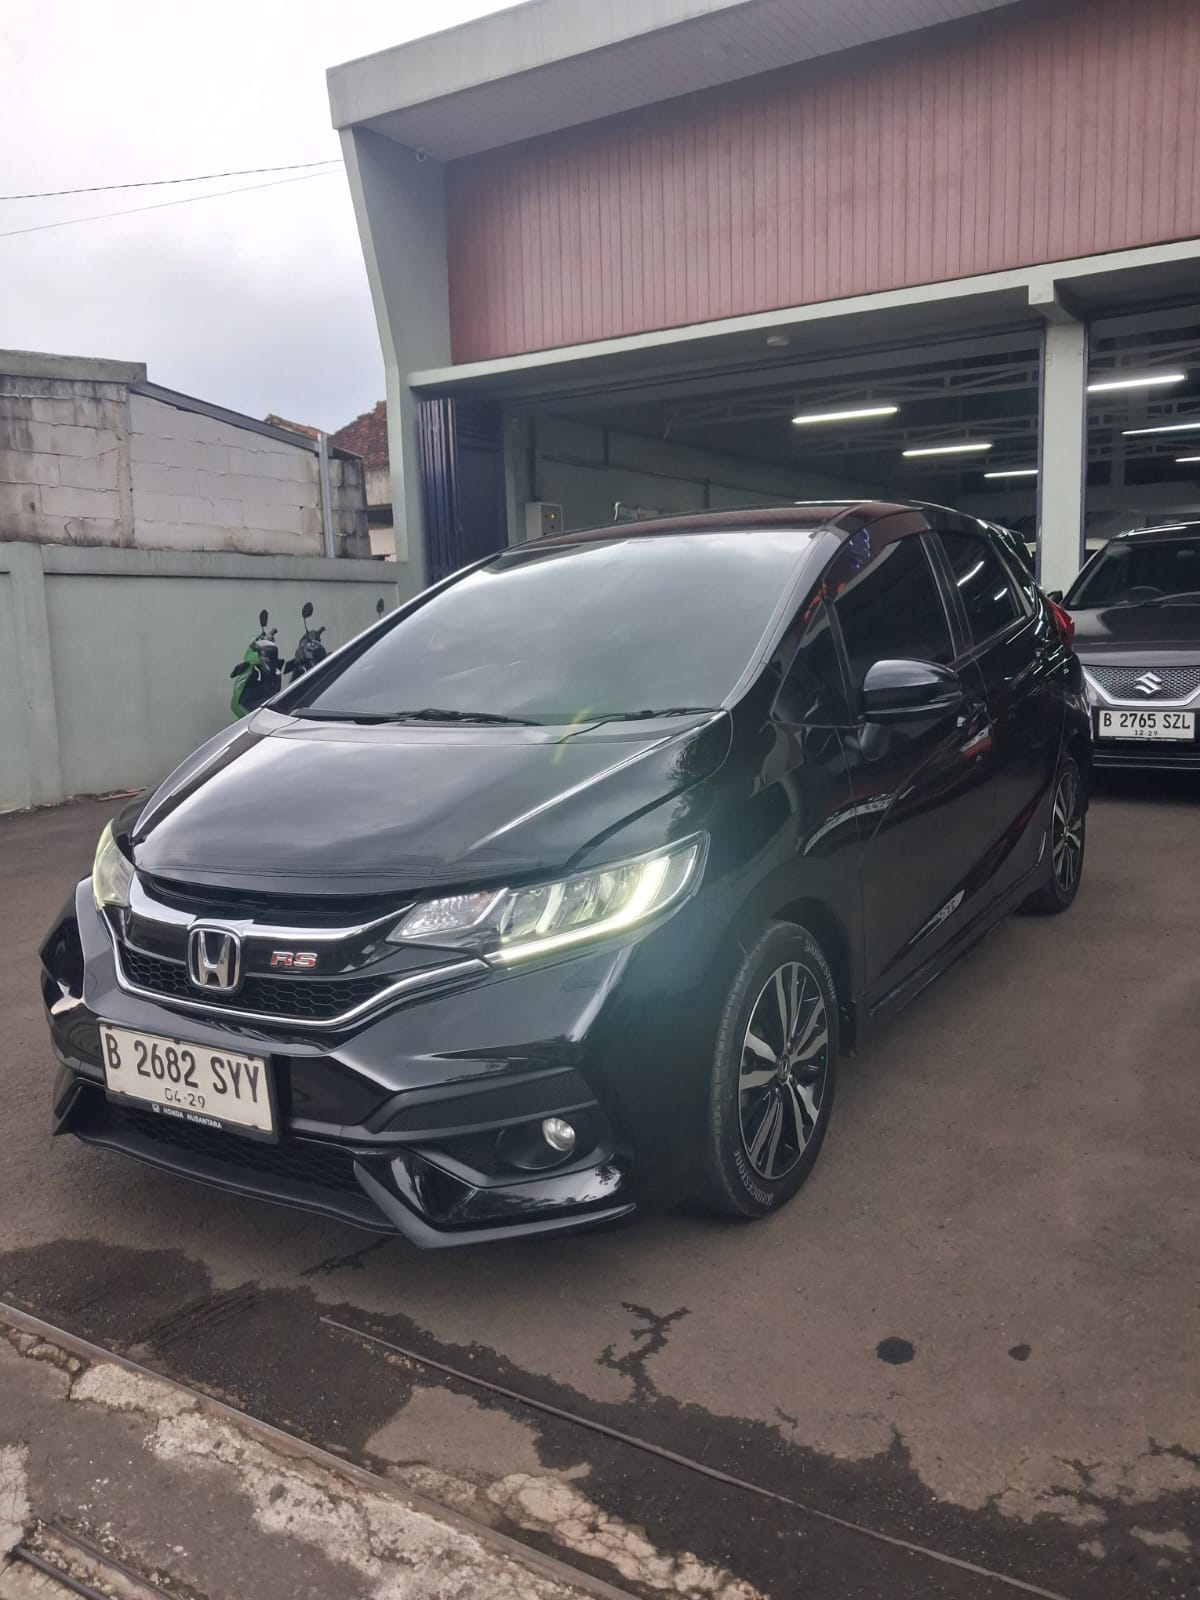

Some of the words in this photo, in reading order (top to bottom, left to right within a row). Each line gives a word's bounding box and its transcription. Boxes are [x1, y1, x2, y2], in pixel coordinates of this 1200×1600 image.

[1104, 712, 1112, 727] B
[1120, 712, 1156, 728] 2765
[1163, 713, 1190, 729] SZL
[270, 951, 318, 968] RS
[105, 1033, 121, 1069] B
[134, 1039, 199, 1088] 2682
[210, 1056, 259, 1103] SYY
[163, 1107, 184, 1119] HONDA
